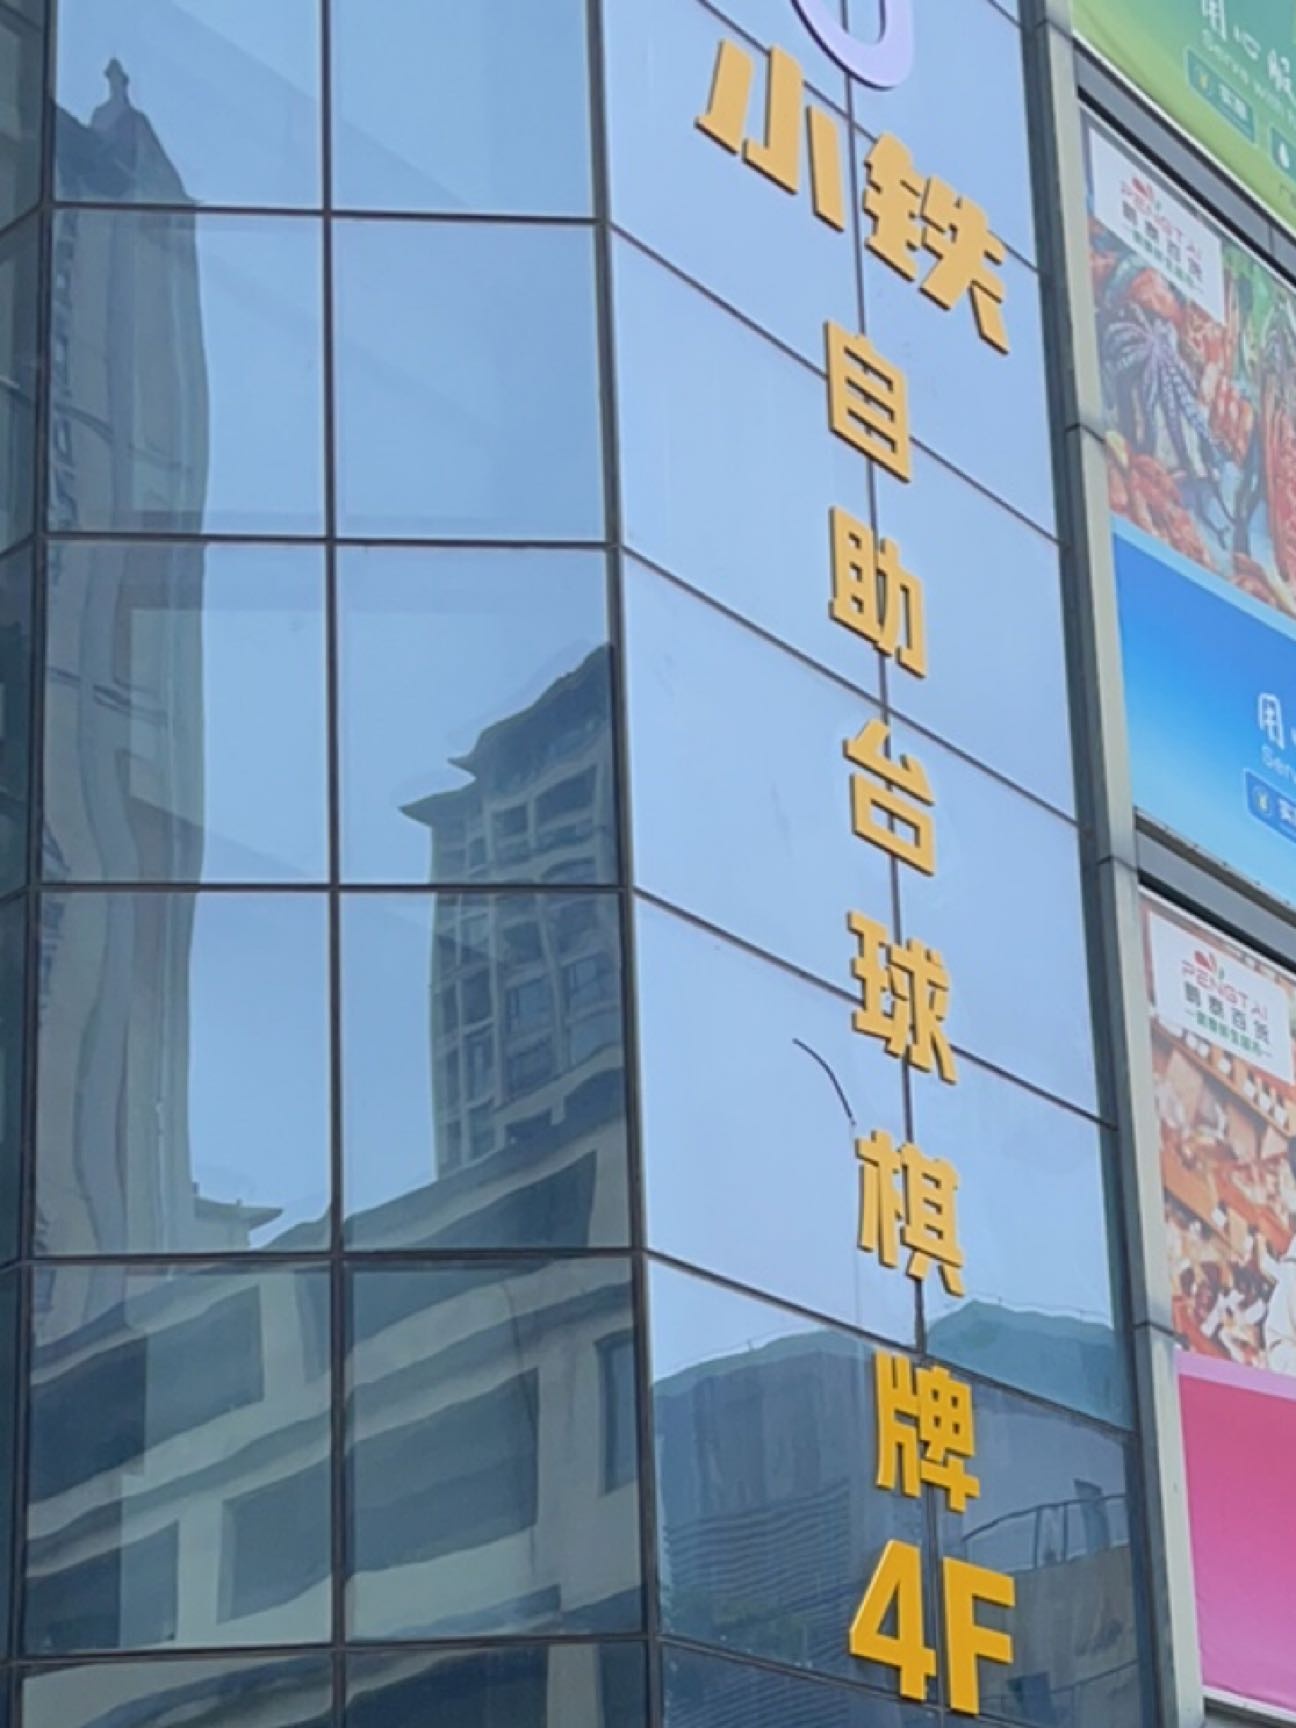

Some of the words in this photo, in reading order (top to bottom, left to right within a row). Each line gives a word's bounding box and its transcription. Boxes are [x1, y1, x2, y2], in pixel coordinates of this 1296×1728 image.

[694, 38, 1009, 355] 小铁
[824, 318, 980, 1510] 自助台球棋牌
[848, 1538, 1016, 1716] 4F
